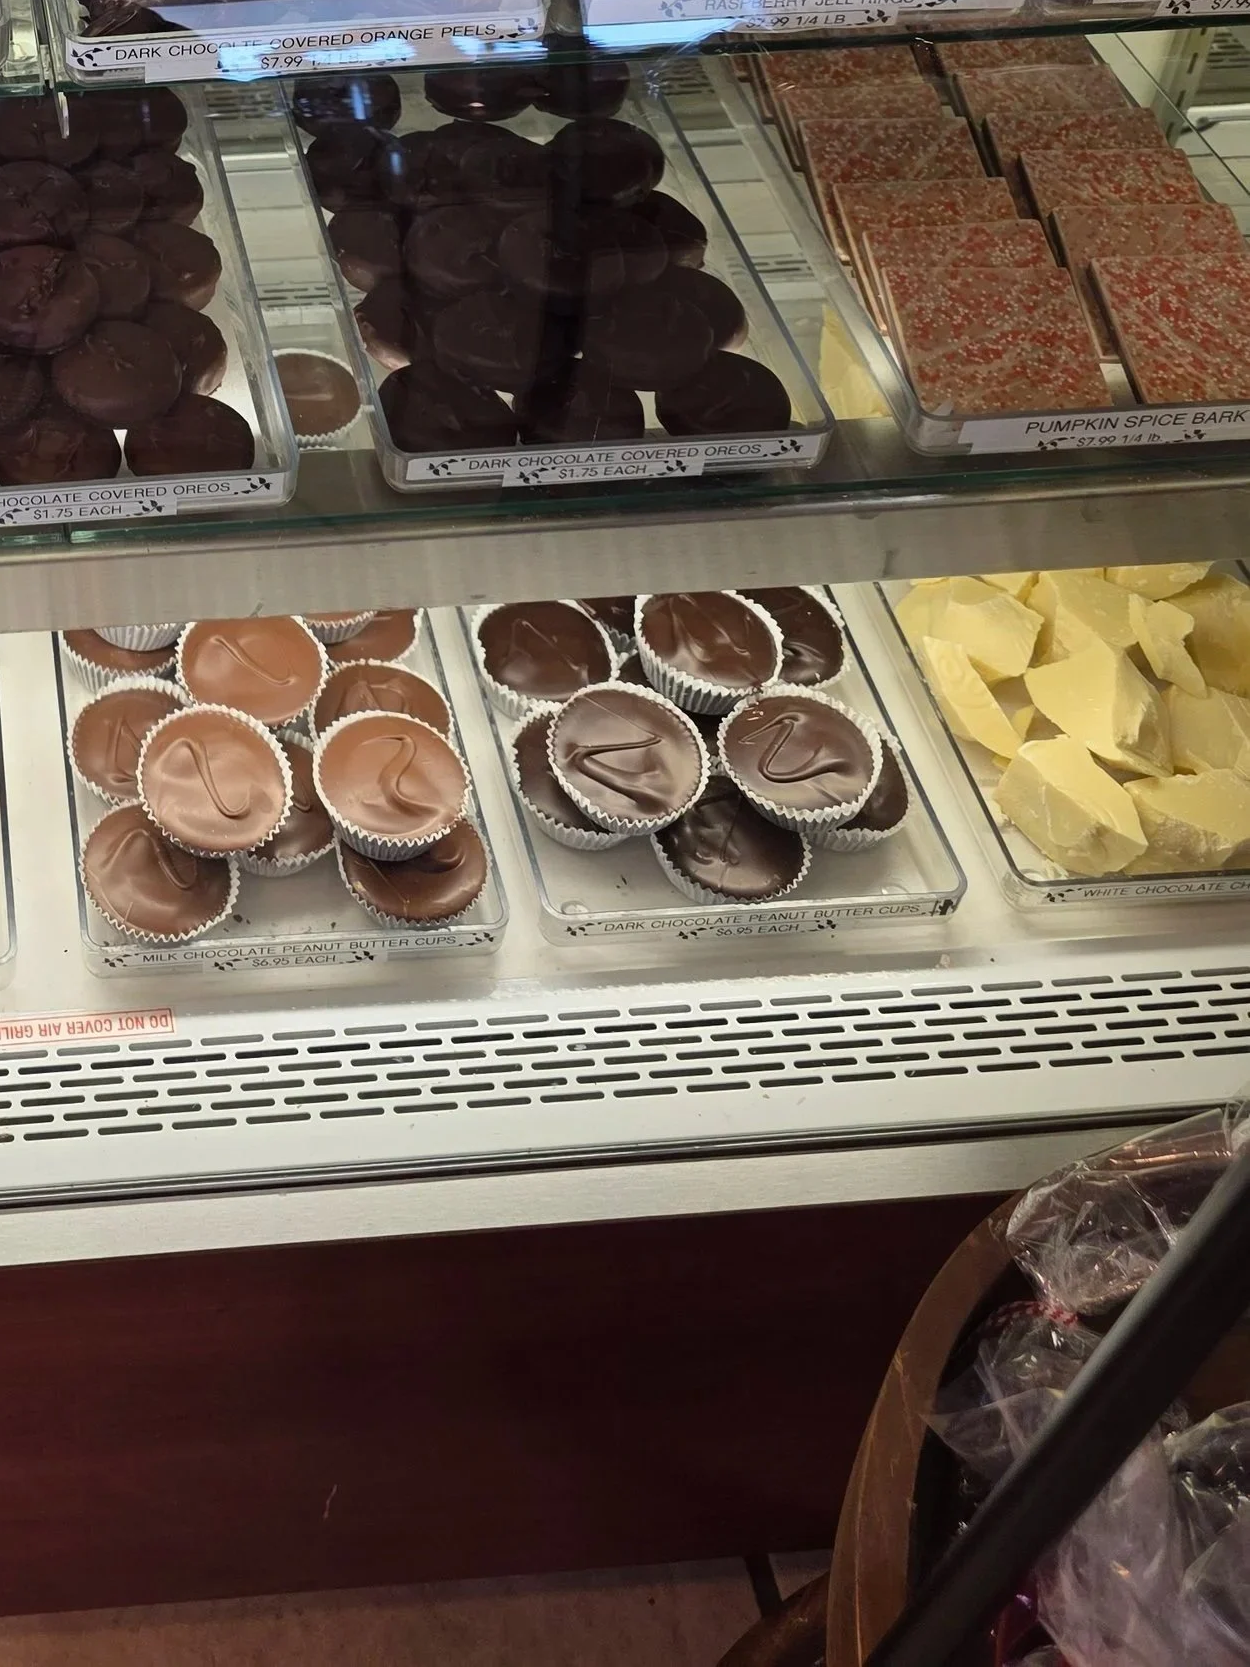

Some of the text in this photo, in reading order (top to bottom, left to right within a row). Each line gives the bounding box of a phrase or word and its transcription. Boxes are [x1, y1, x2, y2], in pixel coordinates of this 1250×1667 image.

[1025, 410, 1248, 434] PUMPKIN SPICE BARK
[469, 444, 762, 471] DARK CHOCOLATE COVERED OREOS
[558, 464, 647, 480] $1.75 EACH
[88, 486, 167, 502] COVERED
[172, 482, 231, 495] OREOS
[33, 505, 122, 520] $1.75 EACH
[1084, 886, 1129, 898] WHITE
[1135, 882, 1226, 895] CHOCOLATE
[603, 904, 920, 932] DARK CHOCOLATE PEANUT BUTTER CUPS
[142, 935, 457, 964] MILK CHOCOLATE PEANUT BUTTER CUPS
[251, 954, 336, 968] $6.95 EACH
[66, 1018, 113, 1034] COVER
[117, 1016, 145, 1031] NOT
[149, 1013, 169, 1028] DO
[37, 1021, 62, 1037] AIR
